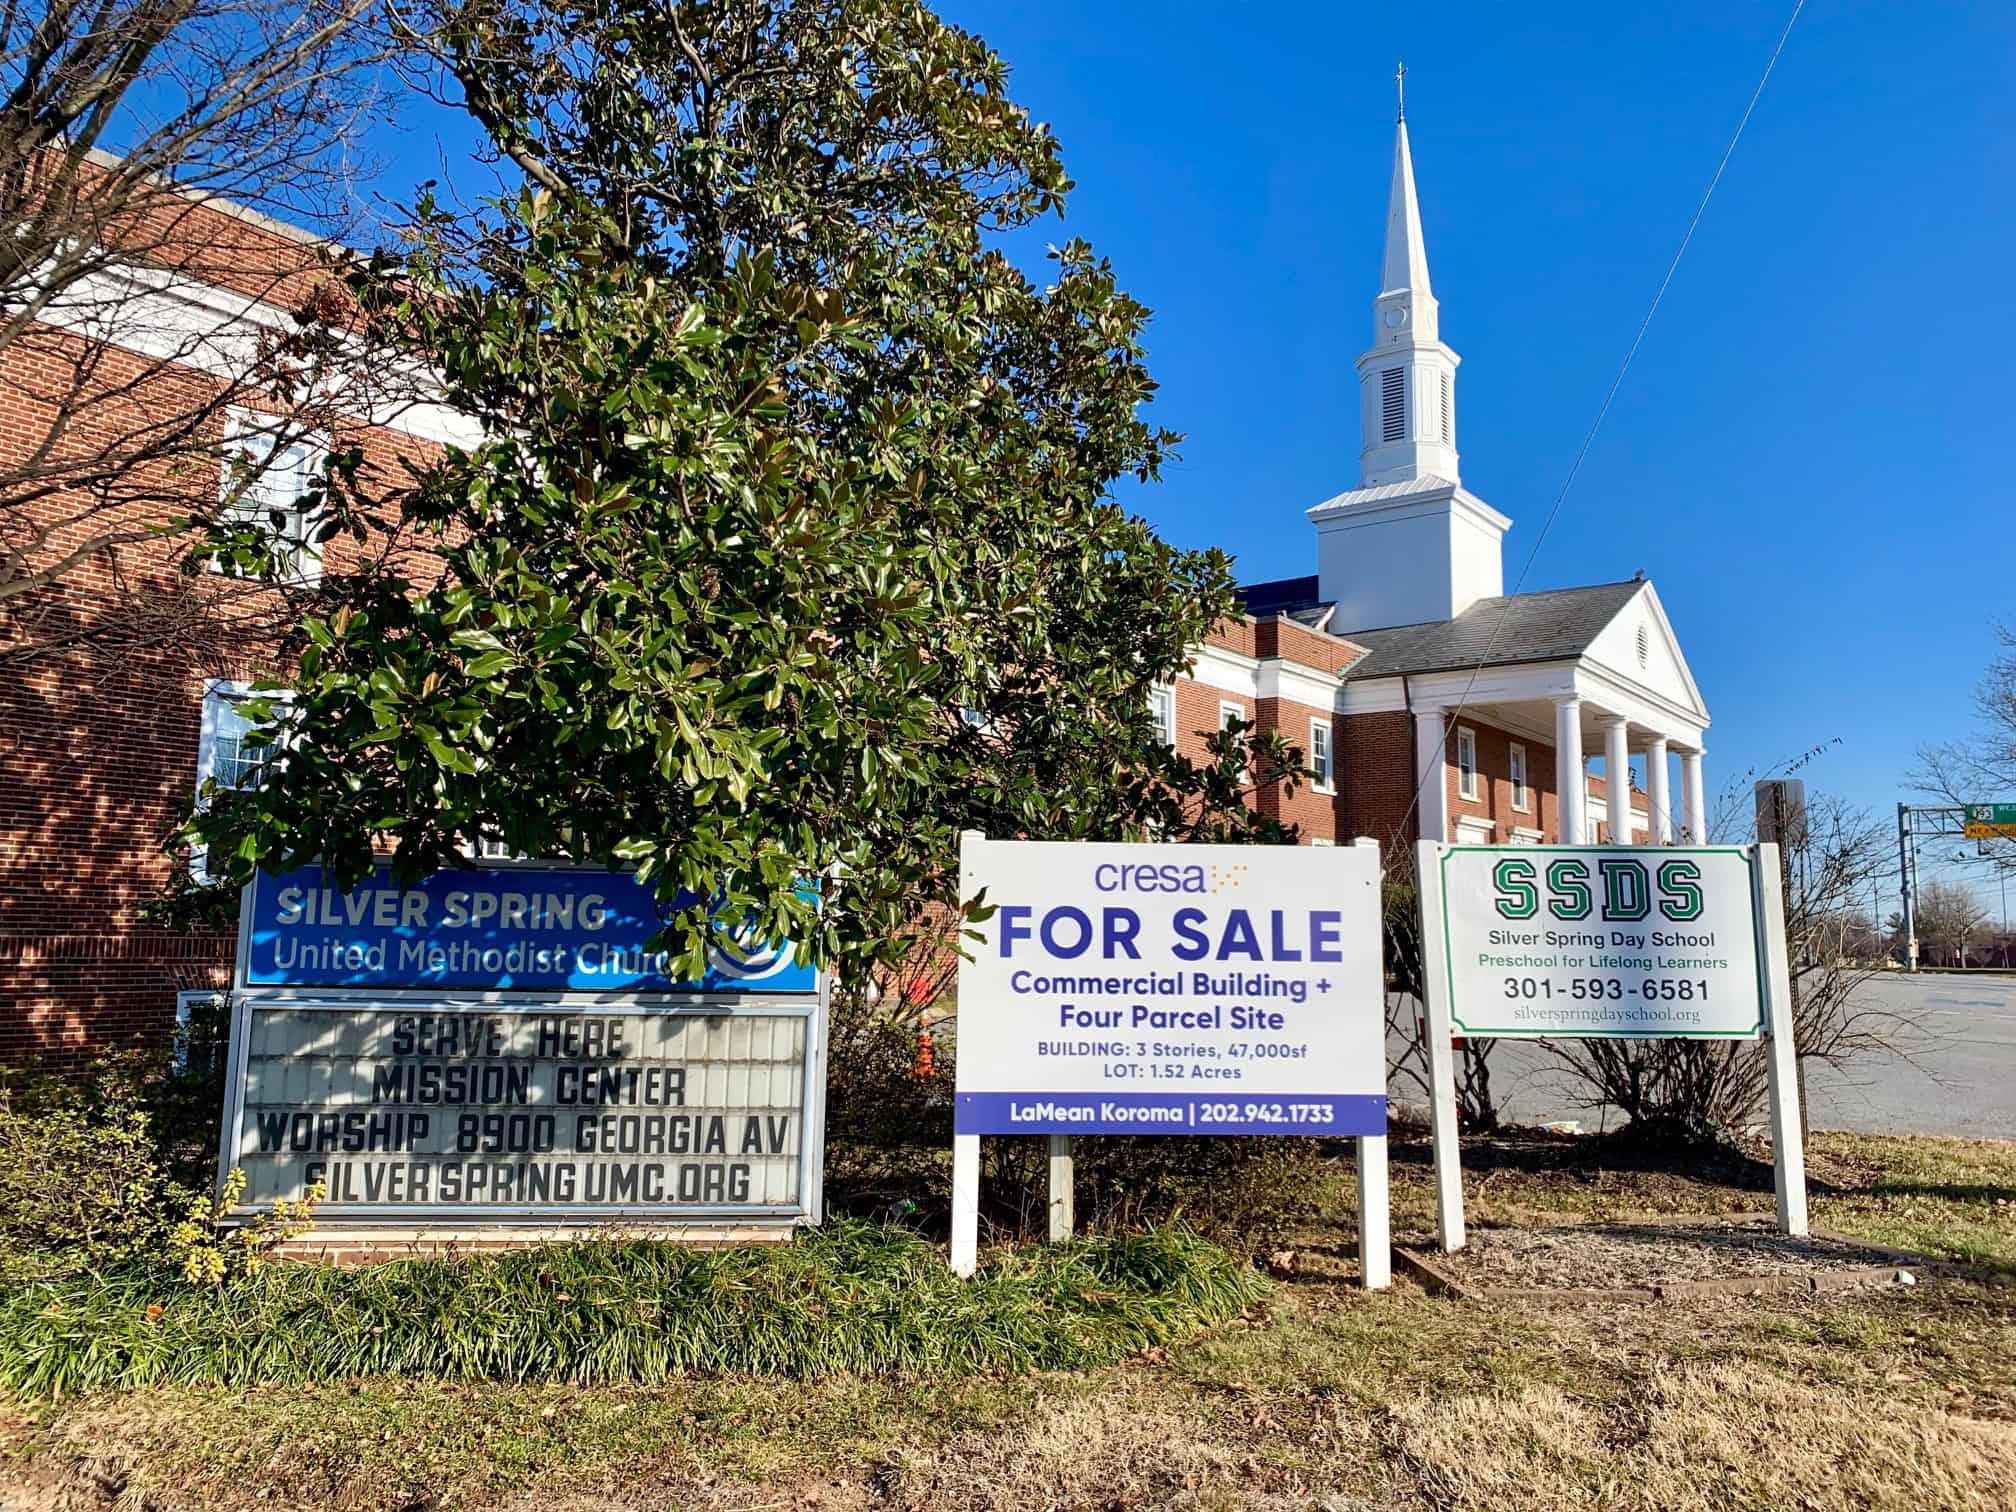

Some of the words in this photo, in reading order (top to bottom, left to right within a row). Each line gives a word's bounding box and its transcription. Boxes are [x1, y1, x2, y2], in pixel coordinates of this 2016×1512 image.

[1095, 864, 1207, 893] cresa
[1493, 858, 1704, 921] SSDS
[275, 887, 427, 928] SILVER
[442, 892, 606, 931] SPRING
[1000, 906, 1141, 960] FOR
[1172, 909, 1343, 963] SALE
[1489, 930, 1540, 945] Silver
[1546, 931, 1605, 949] Spring
[1611, 932, 1646, 949] Day
[1652, 932, 1715, 947] School
[275, 937, 386, 971] United
[400, 939, 565, 975] Methodist
[1479, 954, 1558, 967] Preschool
[1563, 954, 1584, 967] for
[1590, 955, 1652, 971] Lifelong
[1658, 956, 1728, 969] Learners
[1011, 971, 1182, 996] Commercial
[1193, 972, 1306, 1003] Building
[1504, 978, 1709, 1001] 301-593-6581
[1060, 1005, 1123, 1028] Four
[1132, 1005, 1220, 1029] Parcel
[1230, 1006, 1284, 1030] Site
[1514, 1006, 1701, 1024] silverspringdayschool.org
[393, 1017, 502, 1057] SERVE
[538, 1019, 624, 1058] HERE
[1038, 1042, 1131, 1057] BUILDING:
[1137, 1042, 1147, 1057] 3
[1153, 1043, 1222, 1060] Stories,
[1228, 1043, 1307, 1060] 47,000sf
[372, 1065, 528, 1103] MISSION
[557, 1067, 686, 1106] CENTER
[1104, 1063, 1144, 1078] LOT:
[1150, 1063, 1185, 1079] 1.52
[1191, 1064, 1242, 1079] Acres
[1011, 1104, 1094, 1121] LaMean
[1101, 1104, 1183, 1122] Koroma
[1200, 1104, 1334, 1123] 202.942.1733
[256, 1112, 429, 1152] WORSHIP
[457, 1114, 555, 1153] 8900
[575, 1115, 725, 1154] GEORGIA
[742, 1115, 788, 1154] AV
